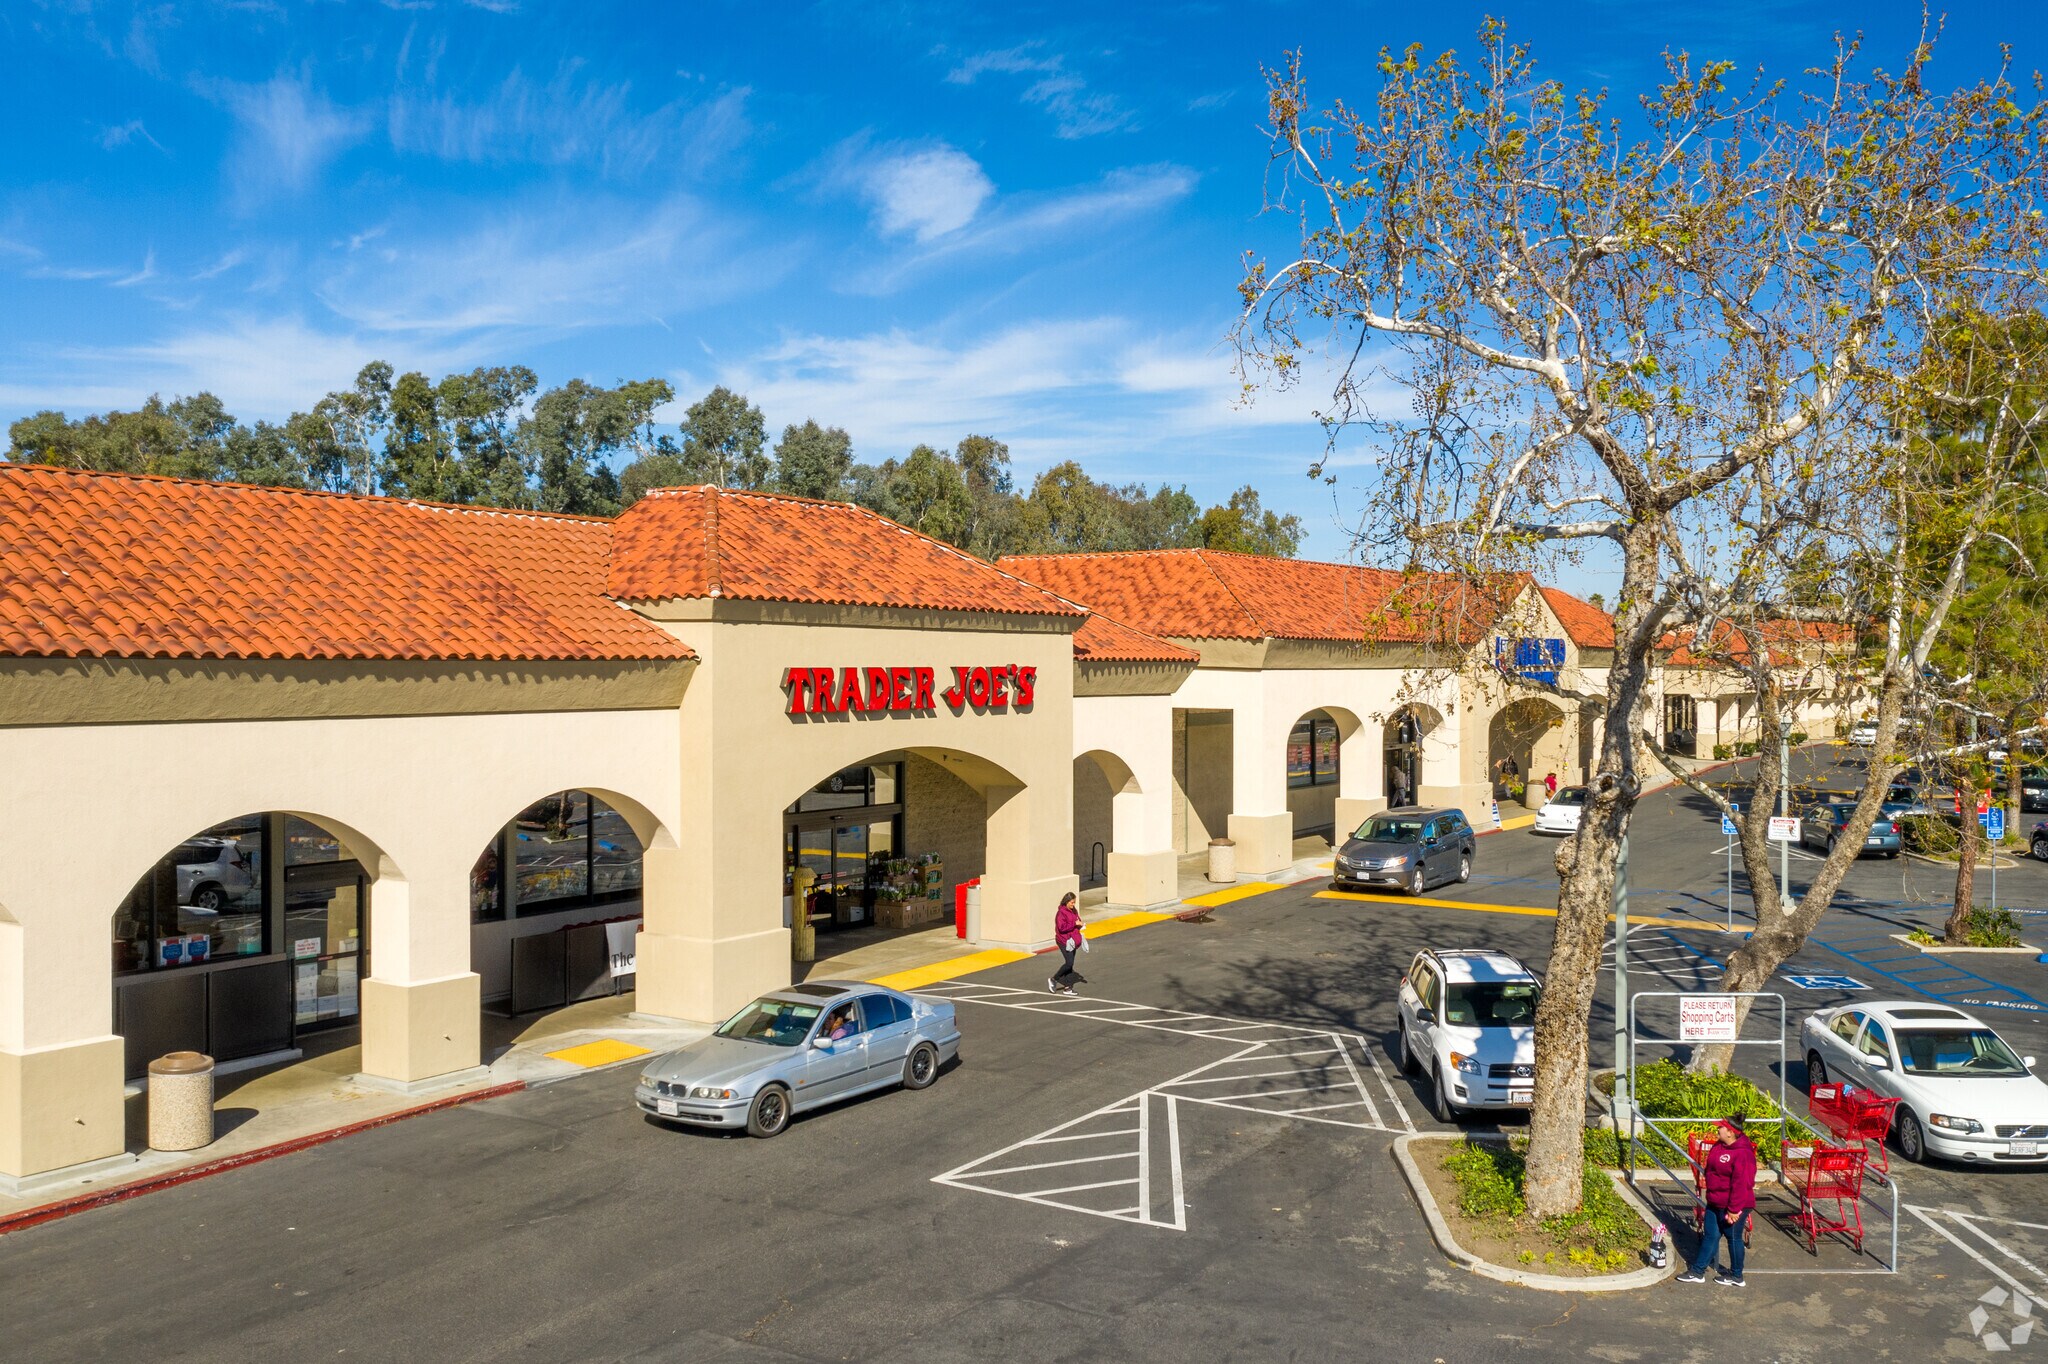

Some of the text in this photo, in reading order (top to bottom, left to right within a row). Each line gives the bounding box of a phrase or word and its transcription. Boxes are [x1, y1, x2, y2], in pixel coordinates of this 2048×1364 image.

[783, 663, 1037, 714] TRADER JOE'S
[611, 952, 634, 968] The
[1683, 1001, 1732, 1010] PLEASE RETURN
[1985, 1000, 2039, 1010] PARKING
[1681, 1010, 1734, 1025] Shopping Carts
[1685, 1027, 1704, 1035] HERE
